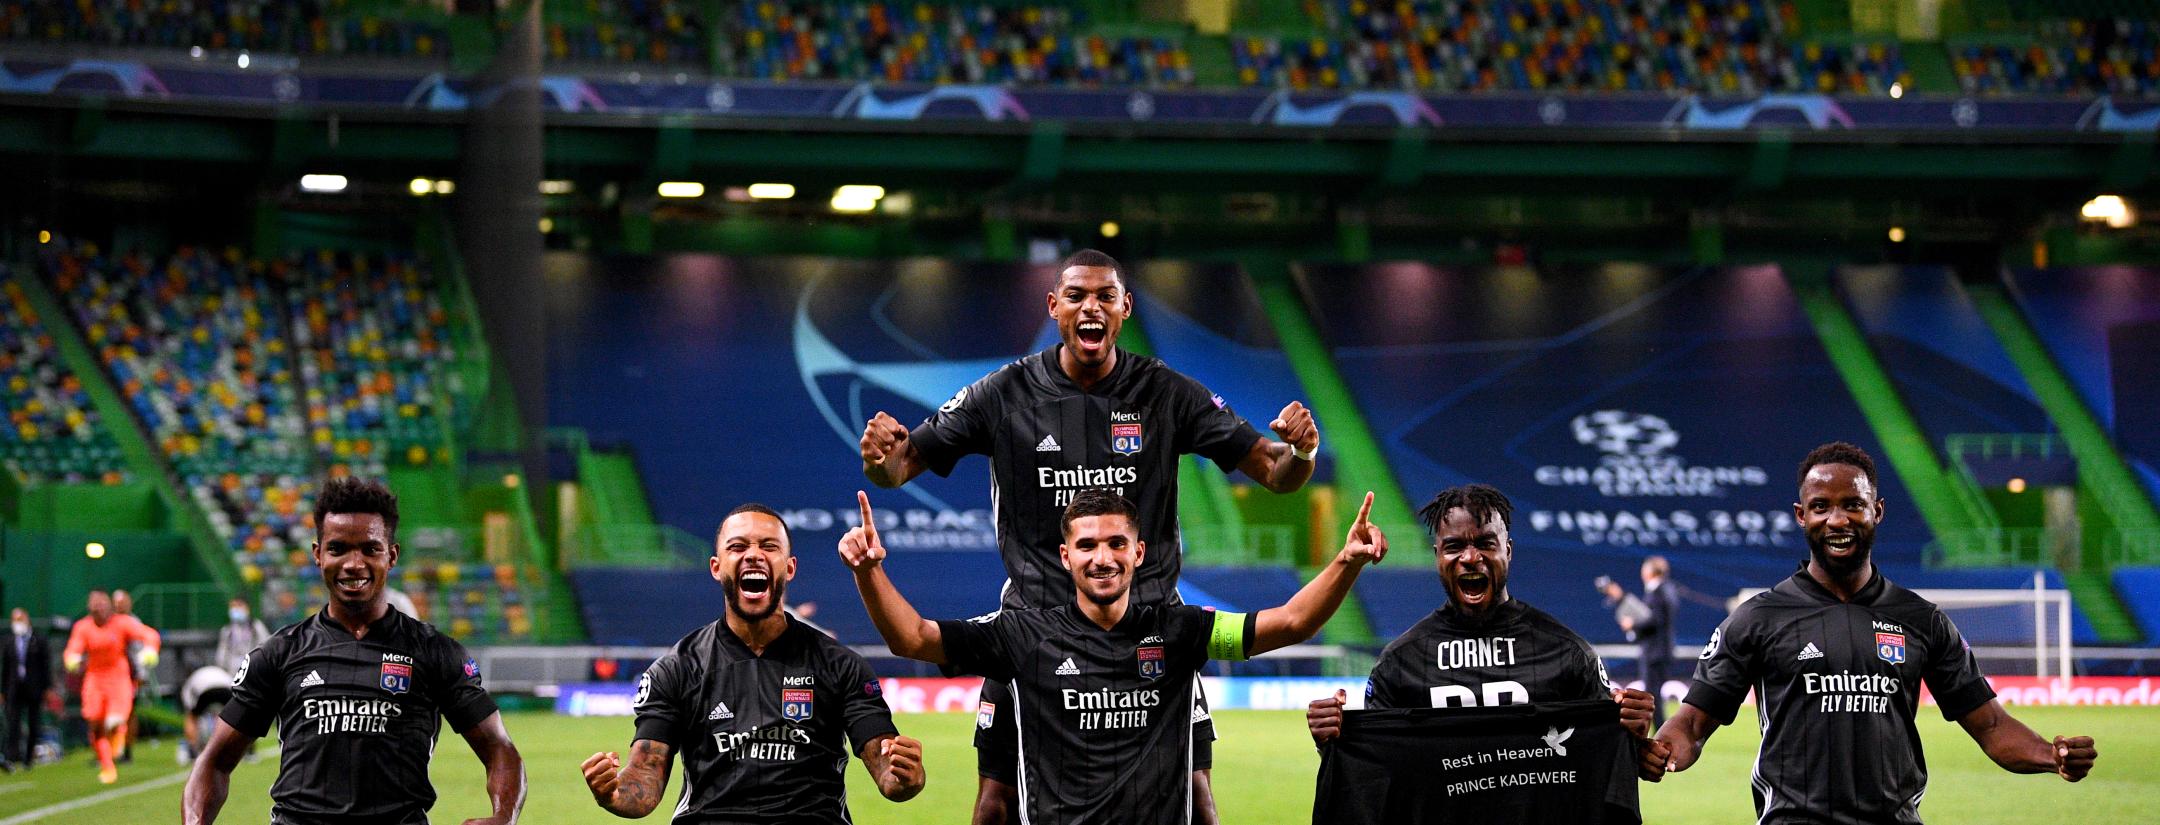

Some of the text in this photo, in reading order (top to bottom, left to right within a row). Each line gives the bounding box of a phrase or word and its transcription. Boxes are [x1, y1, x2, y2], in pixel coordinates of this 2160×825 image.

[1111, 411, 1140, 422] Merci
[1038, 465, 1137, 488] Emirates
[1055, 489, 1076, 507] FLY
[1706, 510, 1796, 532] 202
[1872, 620, 1903, 633] Merci
[382, 652, 413, 665] Merci
[1437, 637, 1516, 670] CORNET
[1797, 651, 1824, 661] adidas
[783, 674, 815, 686] Merci
[1803, 669, 1900, 694] Emirates
[303, 696, 402, 719] Emirates
[1062, 687, 1160, 710] Emirates
[1820, 694, 1888, 714] FLY BETTER
[317, 715, 388, 735] FLY BETTER
[708, 711, 734, 720] adidas
[1079, 710, 1148, 730] FLY BETTER
[712, 724, 811, 753] Emirates
[750, 742, 796, 760] BETTER
[1441, 747, 1553, 771] Rest in Heaven
[1446, 770, 1577, 797] PRINCE KADEWERE
